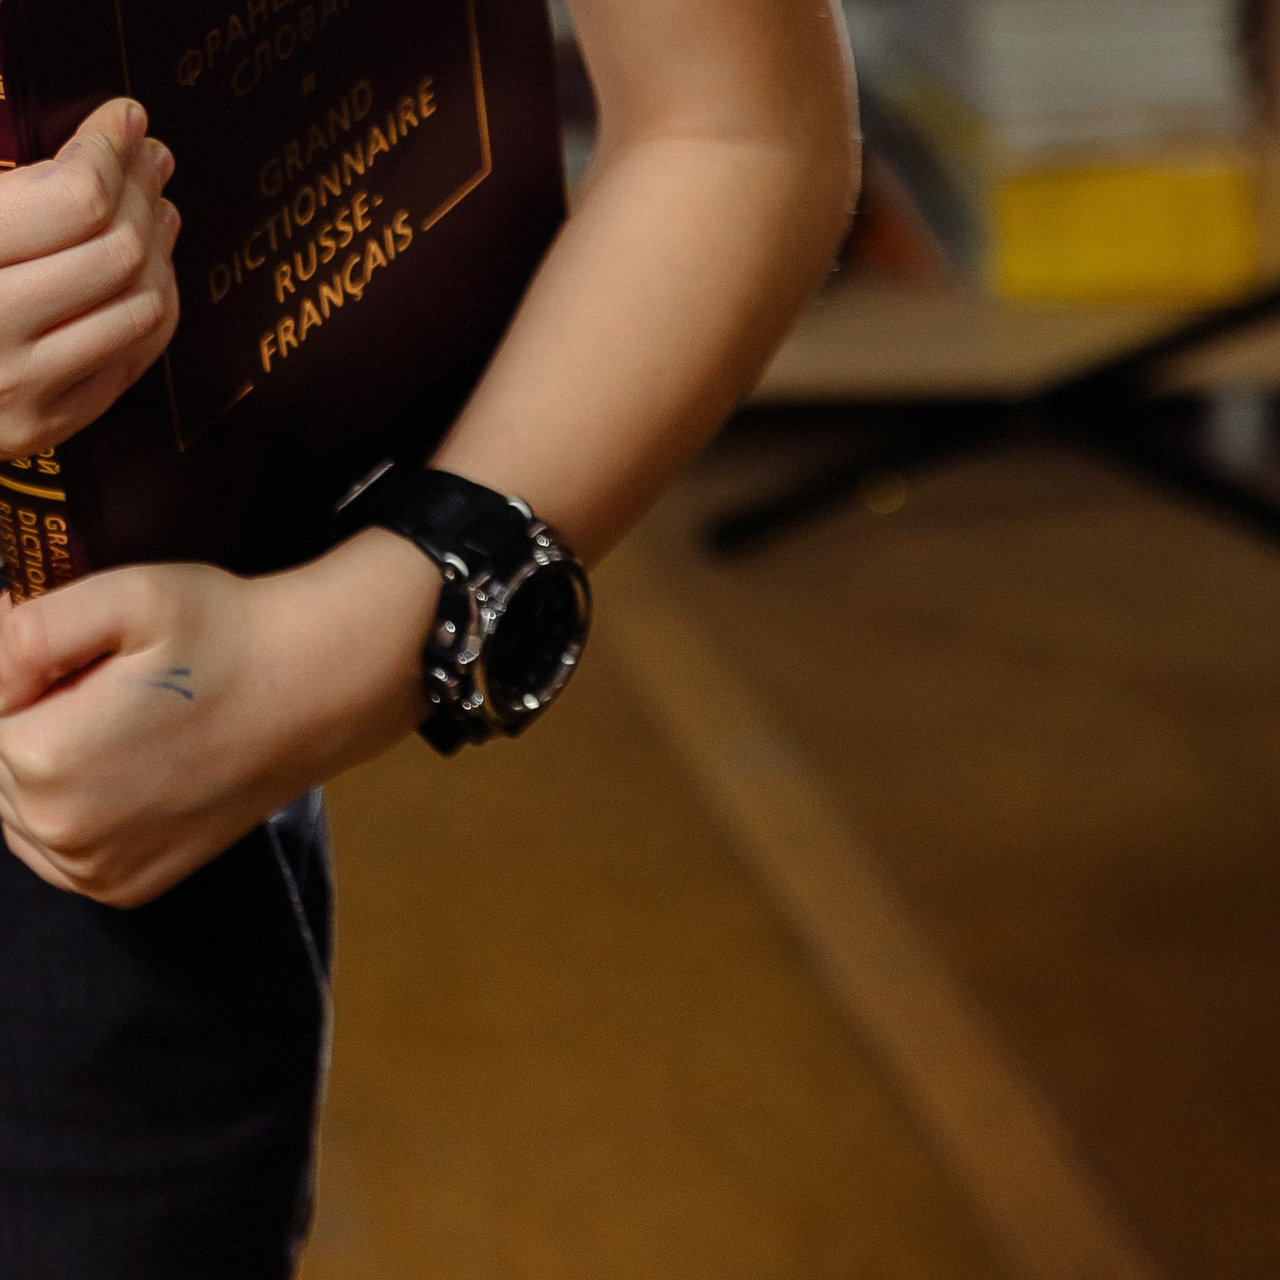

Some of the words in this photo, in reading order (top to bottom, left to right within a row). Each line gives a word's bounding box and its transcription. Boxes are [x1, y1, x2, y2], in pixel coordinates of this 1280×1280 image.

[208, 76, 438, 304] DICTIONNAIRE
[259, 80, 373, 197] GRAND
[259, 208, 414, 374] FRANÇAIS
[274, 189, 384, 304] RUSSE-
